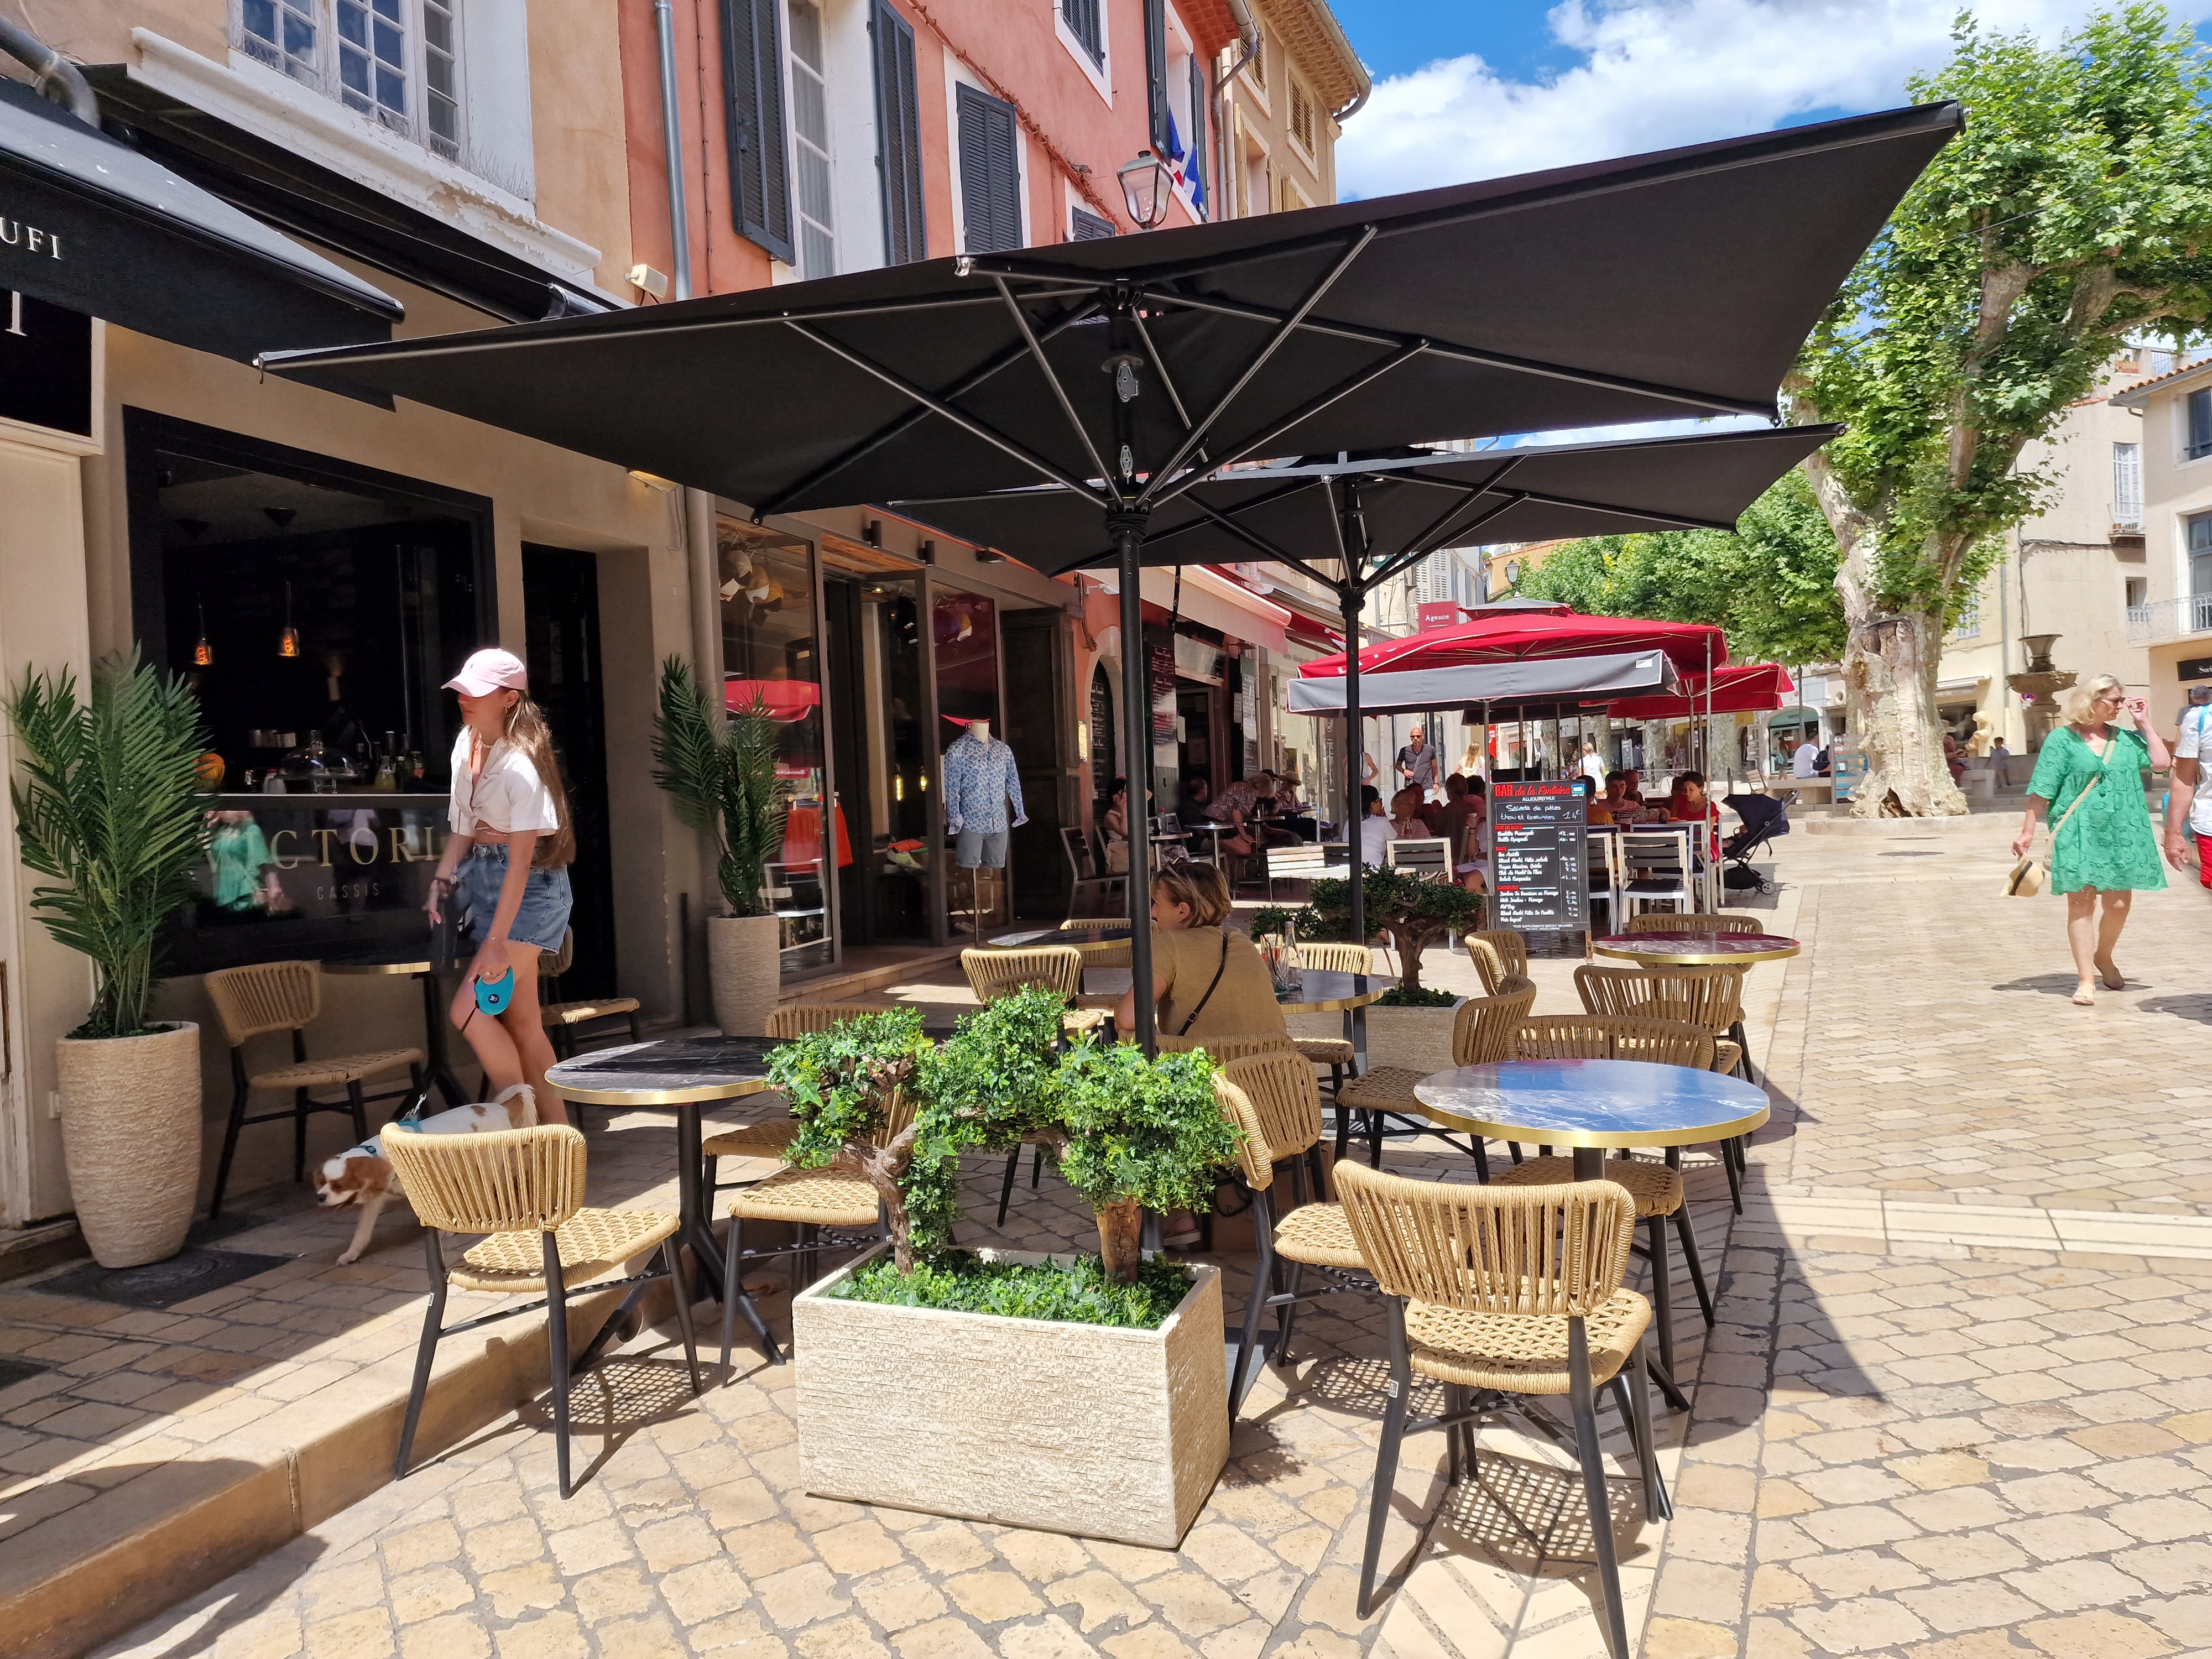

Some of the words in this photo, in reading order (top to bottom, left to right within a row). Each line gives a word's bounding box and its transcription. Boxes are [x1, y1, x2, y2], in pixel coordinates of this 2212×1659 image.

[1494, 784, 1513, 796] BAR
[1514, 785, 1525, 796] de
[1527, 785, 1536, 795] la
[1538, 785, 1571, 795] Fontaine
[317, 883, 379, 900] CASSIS
